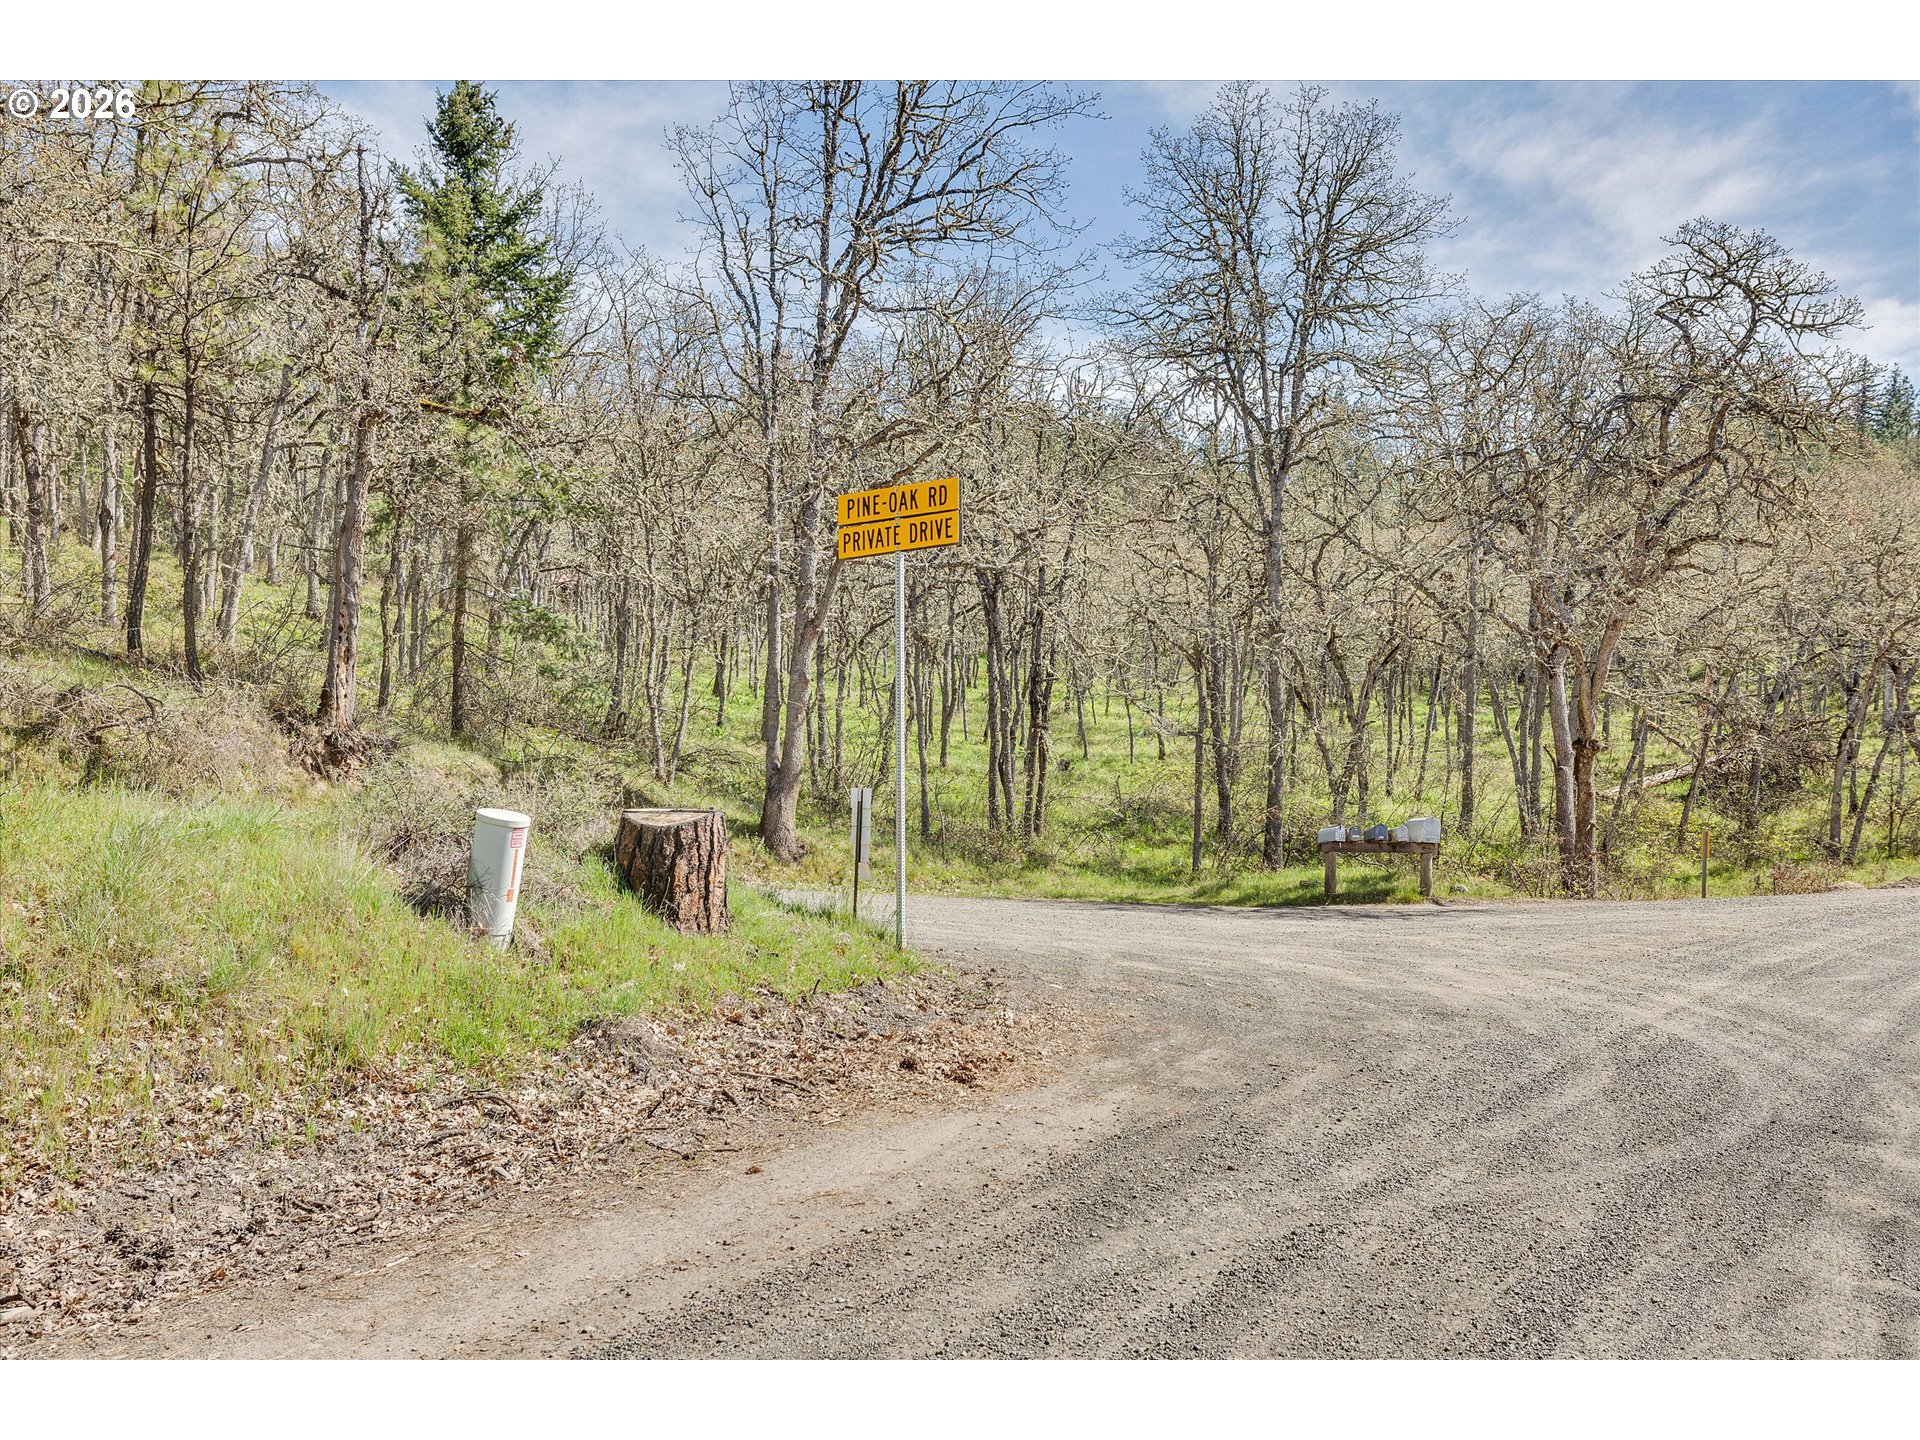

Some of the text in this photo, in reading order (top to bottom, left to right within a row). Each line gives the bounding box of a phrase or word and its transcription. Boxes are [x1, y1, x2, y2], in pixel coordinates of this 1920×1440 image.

[847, 485, 948, 519] PINE-OAK RD
[843, 517, 953, 554] PRIVATE DRIVE
